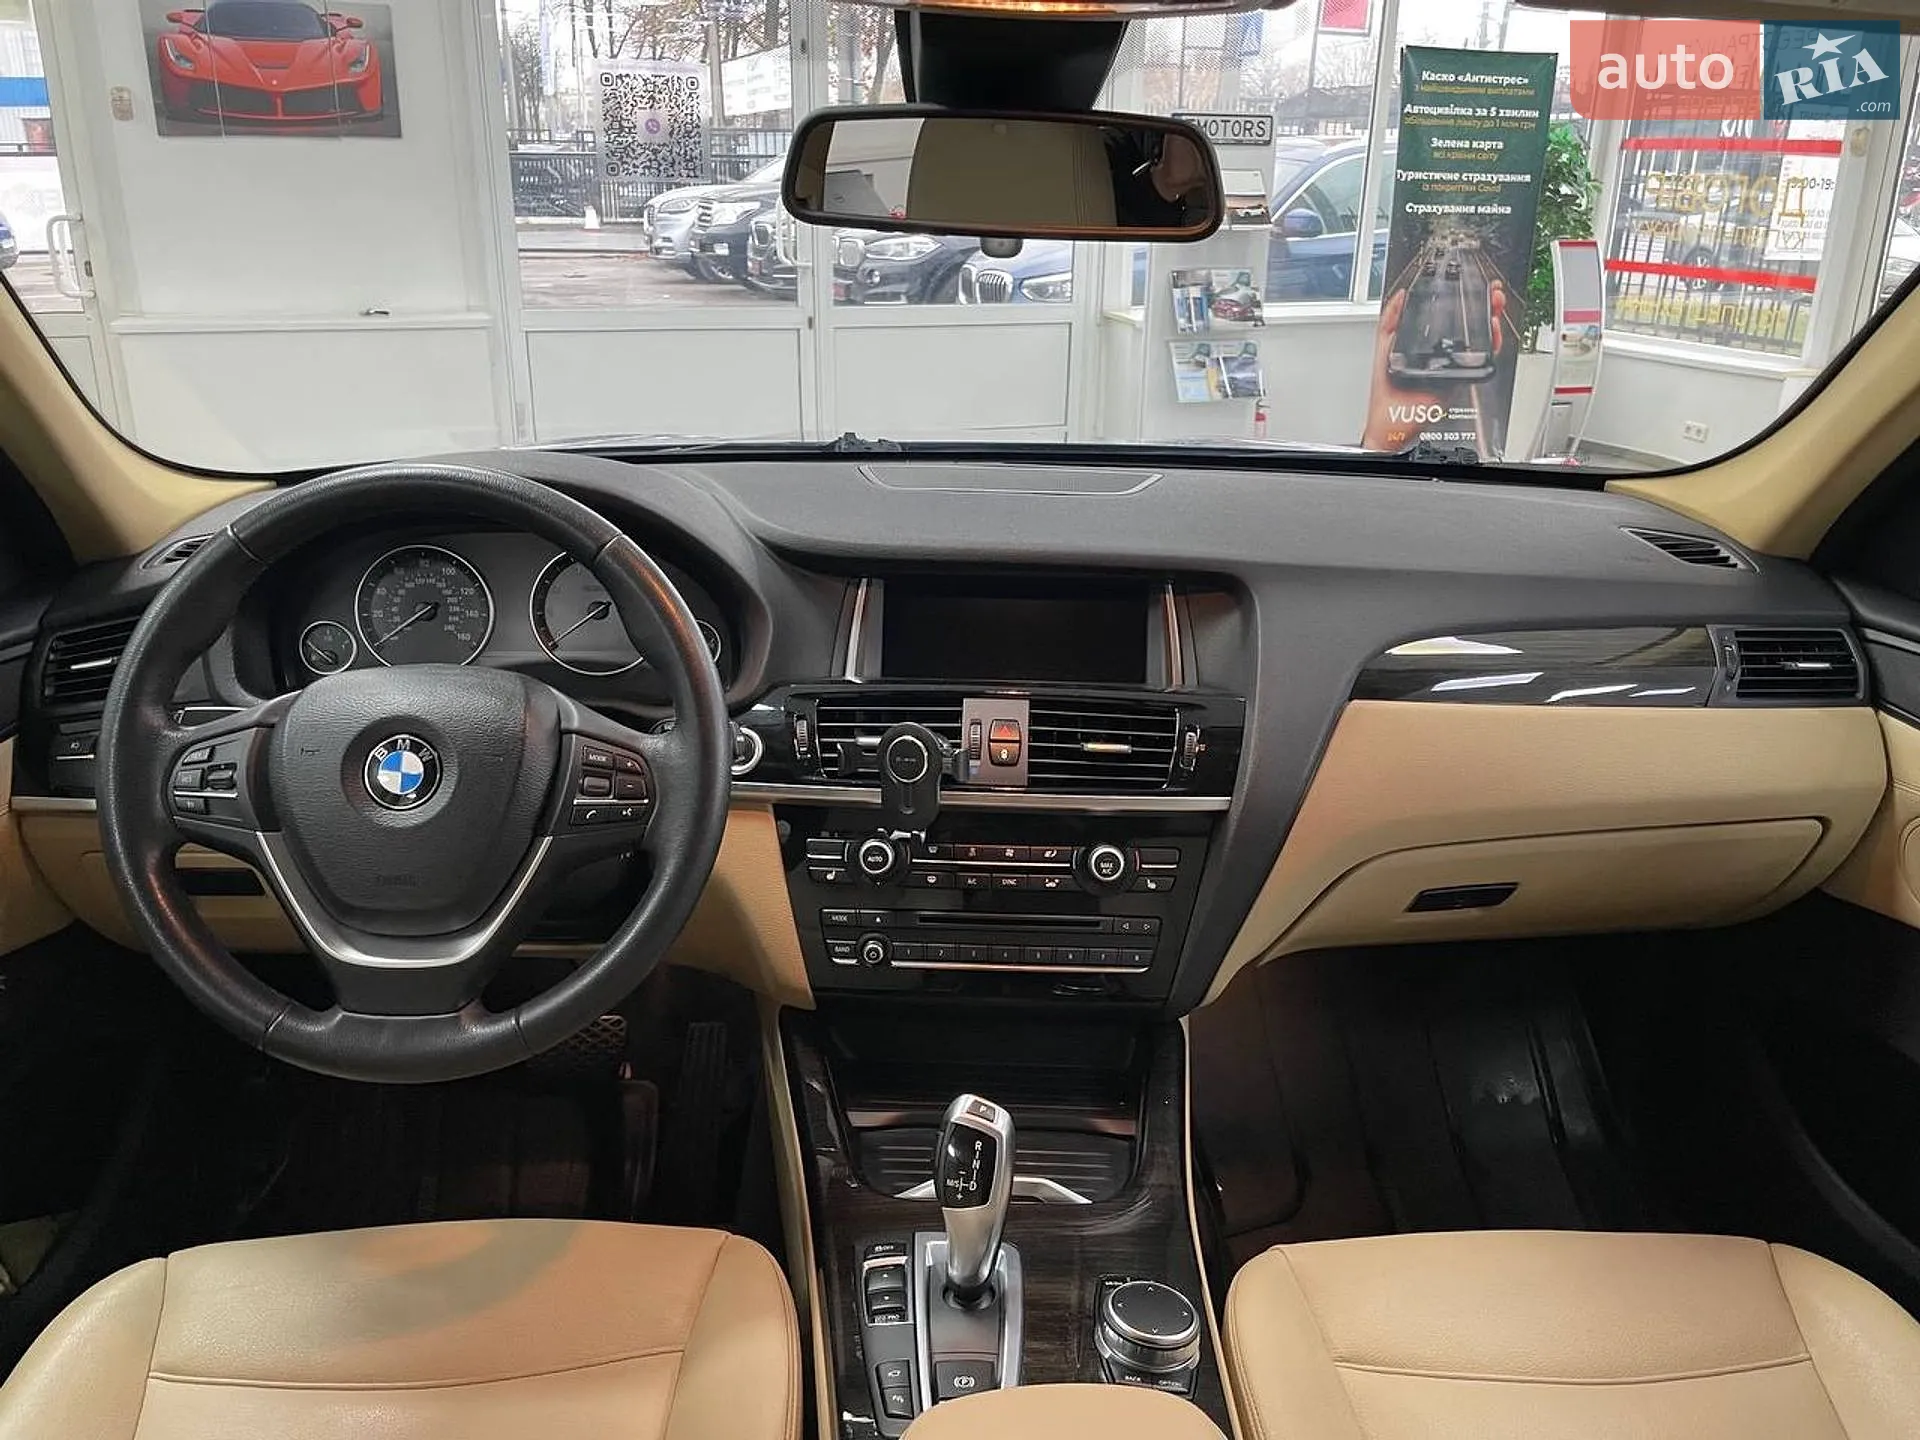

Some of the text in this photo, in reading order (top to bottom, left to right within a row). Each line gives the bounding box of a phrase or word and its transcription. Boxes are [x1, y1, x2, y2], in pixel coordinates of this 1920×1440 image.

[1421, 70, 1455, 82] Каско
[1403, 103, 1540, 118] Автоцивілка за 5 хвилин
[1430, 137, 1504, 151] Зелена карта
[1461, 173, 1532, 184] страхування
[1405, 202, 1512, 215] Страхування майна
[1388, 404, 1443, 423] VUSO
[374, 738, 434, 762] BMW
[867, 855, 883, 863] AUTO
[974, 1140, 983, 1151] R
[972, 1159, 981, 1170] N
[969, 1181, 978, 1192] D
